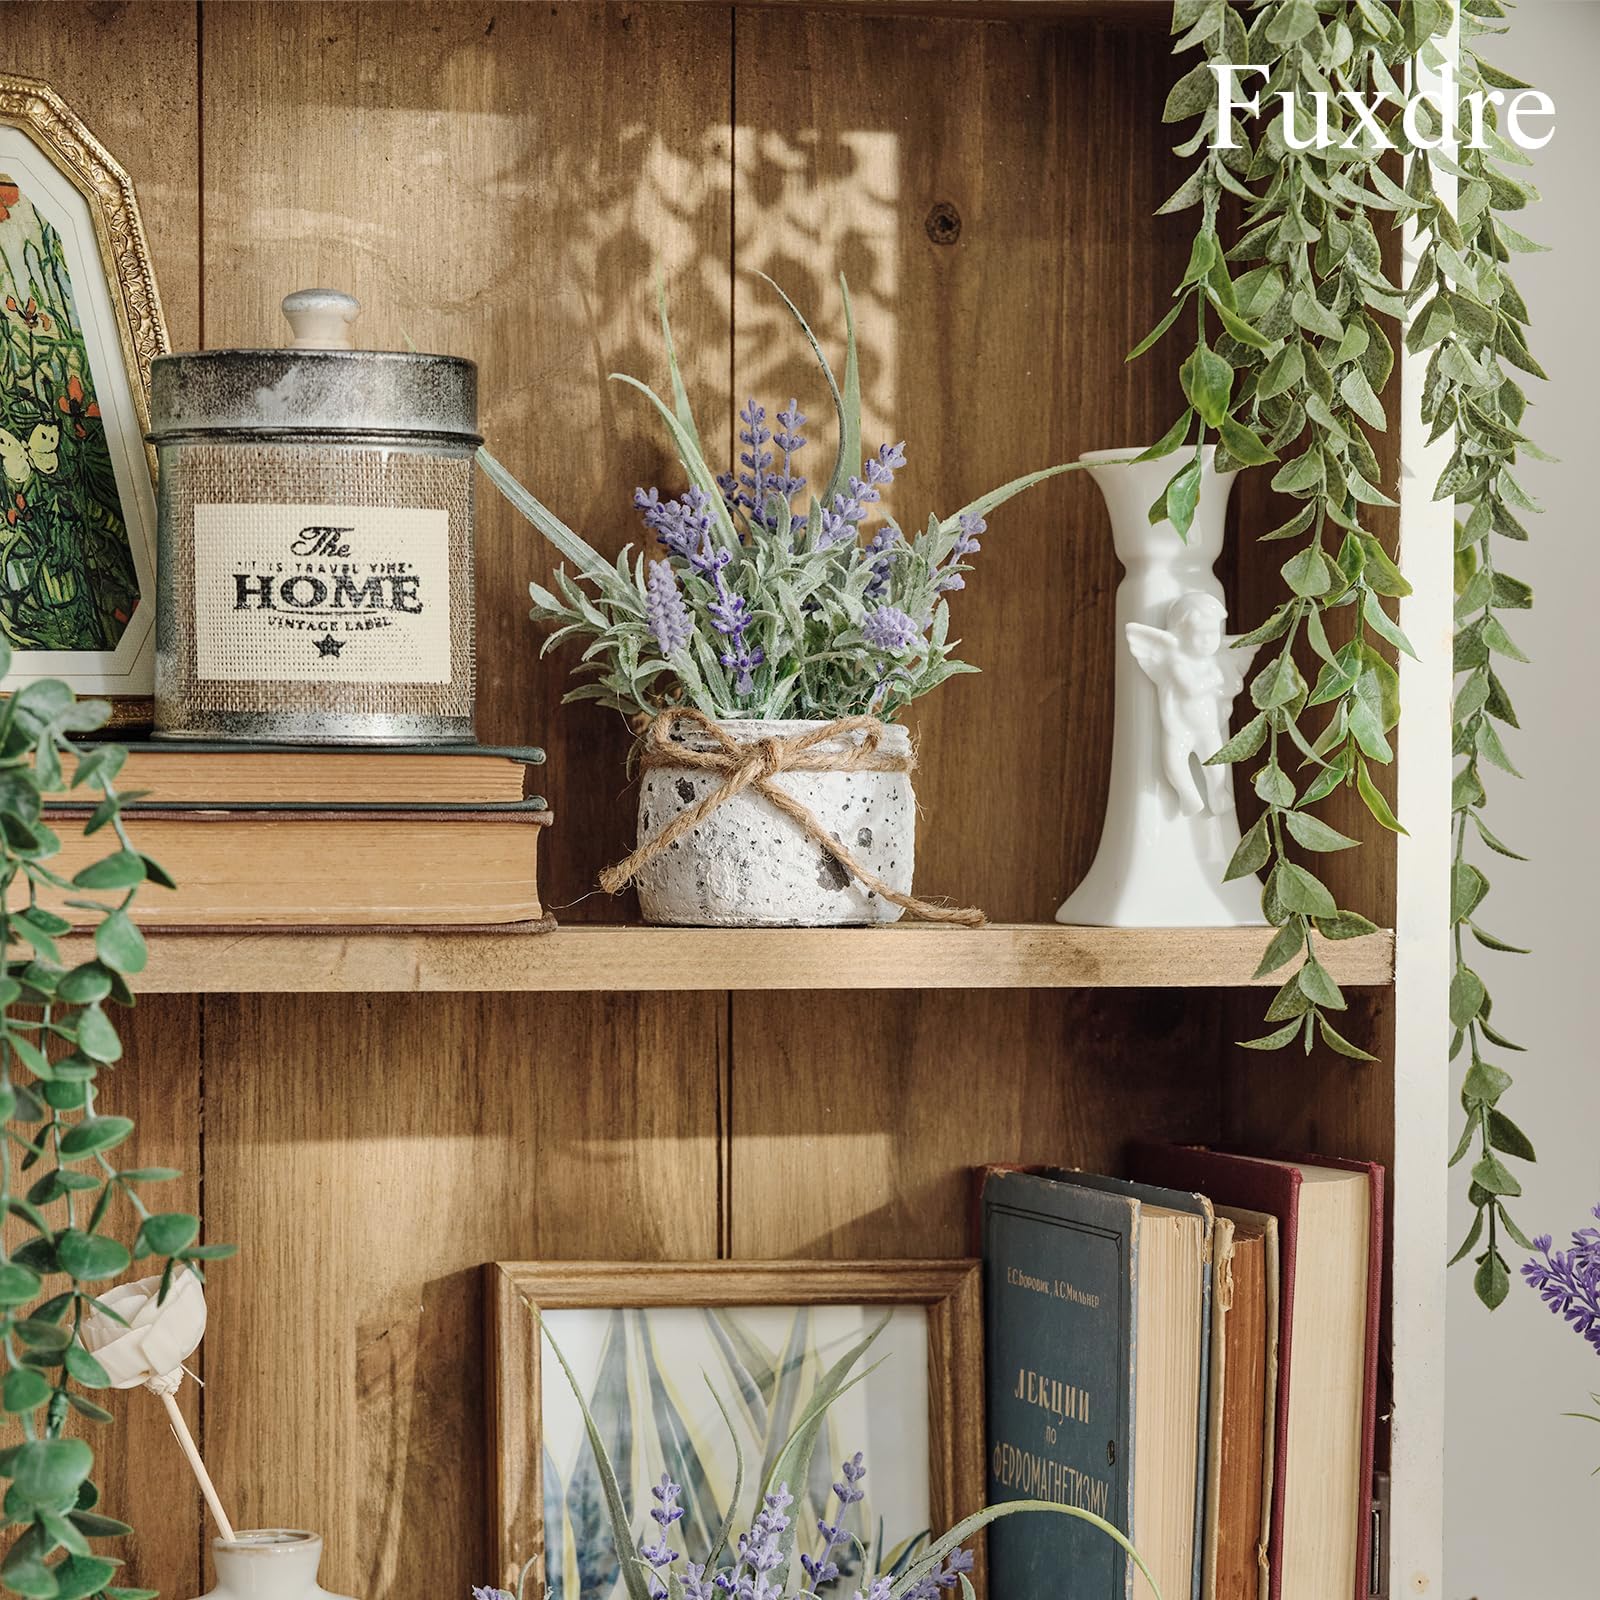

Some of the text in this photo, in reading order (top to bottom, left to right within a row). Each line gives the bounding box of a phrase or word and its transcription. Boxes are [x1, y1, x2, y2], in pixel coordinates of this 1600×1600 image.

[290, 526, 355, 558] The
[232, 573, 424, 615] HOME
[268, 615, 392, 631] VINTAGE LABEL
[1014, 1368, 1090, 1425] ЛЕКЦИИ
